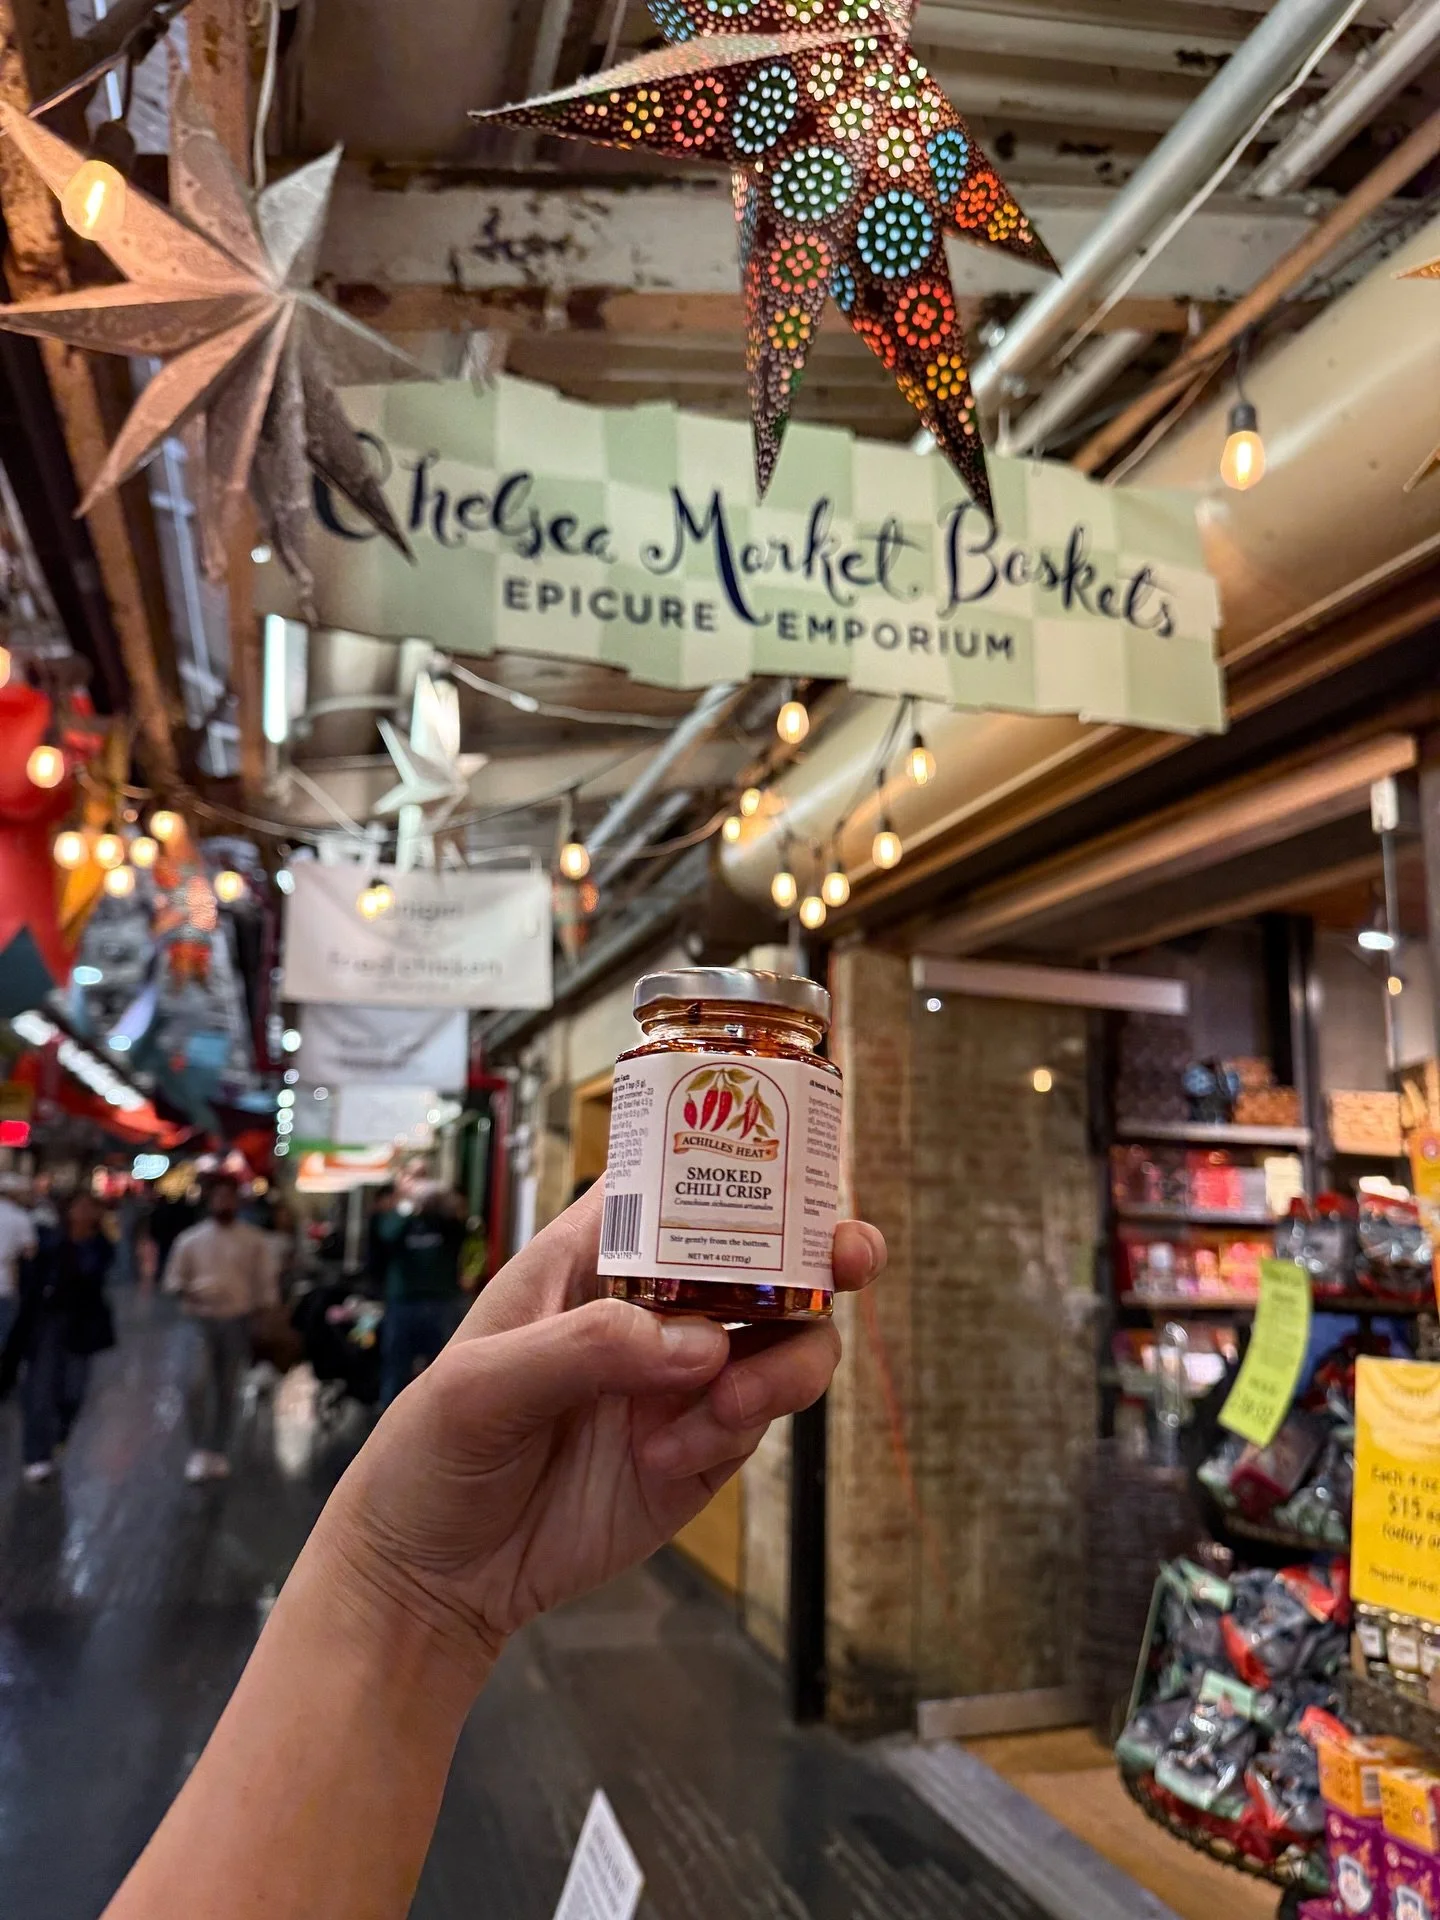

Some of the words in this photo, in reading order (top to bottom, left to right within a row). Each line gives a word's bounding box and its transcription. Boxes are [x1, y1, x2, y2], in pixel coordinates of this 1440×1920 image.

[312, 430, 617, 565] Chelsea
[639, 484, 922, 627] Market
[937, 498, 1177, 637] Baskets
[502, 577, 717, 632] EPICURE
[776, 607, 1015, 661] EMPORIUM
[682, 1136, 733, 1153] ACHILLES
[687, 1167, 762, 1184] SMOKED
[675, 1182, 721, 1197] CHILI
[726, 1184, 772, 1200] CRISP
[670, 1234, 684, 1242] Stir
[685, 1236, 708, 1245] gently
[709, 1237, 728, 1245] from
[742, 1239, 771, 1248] bottom.
[721, 1254, 731, 1262] OZ
[1388, 1490, 1422, 1520] $15
